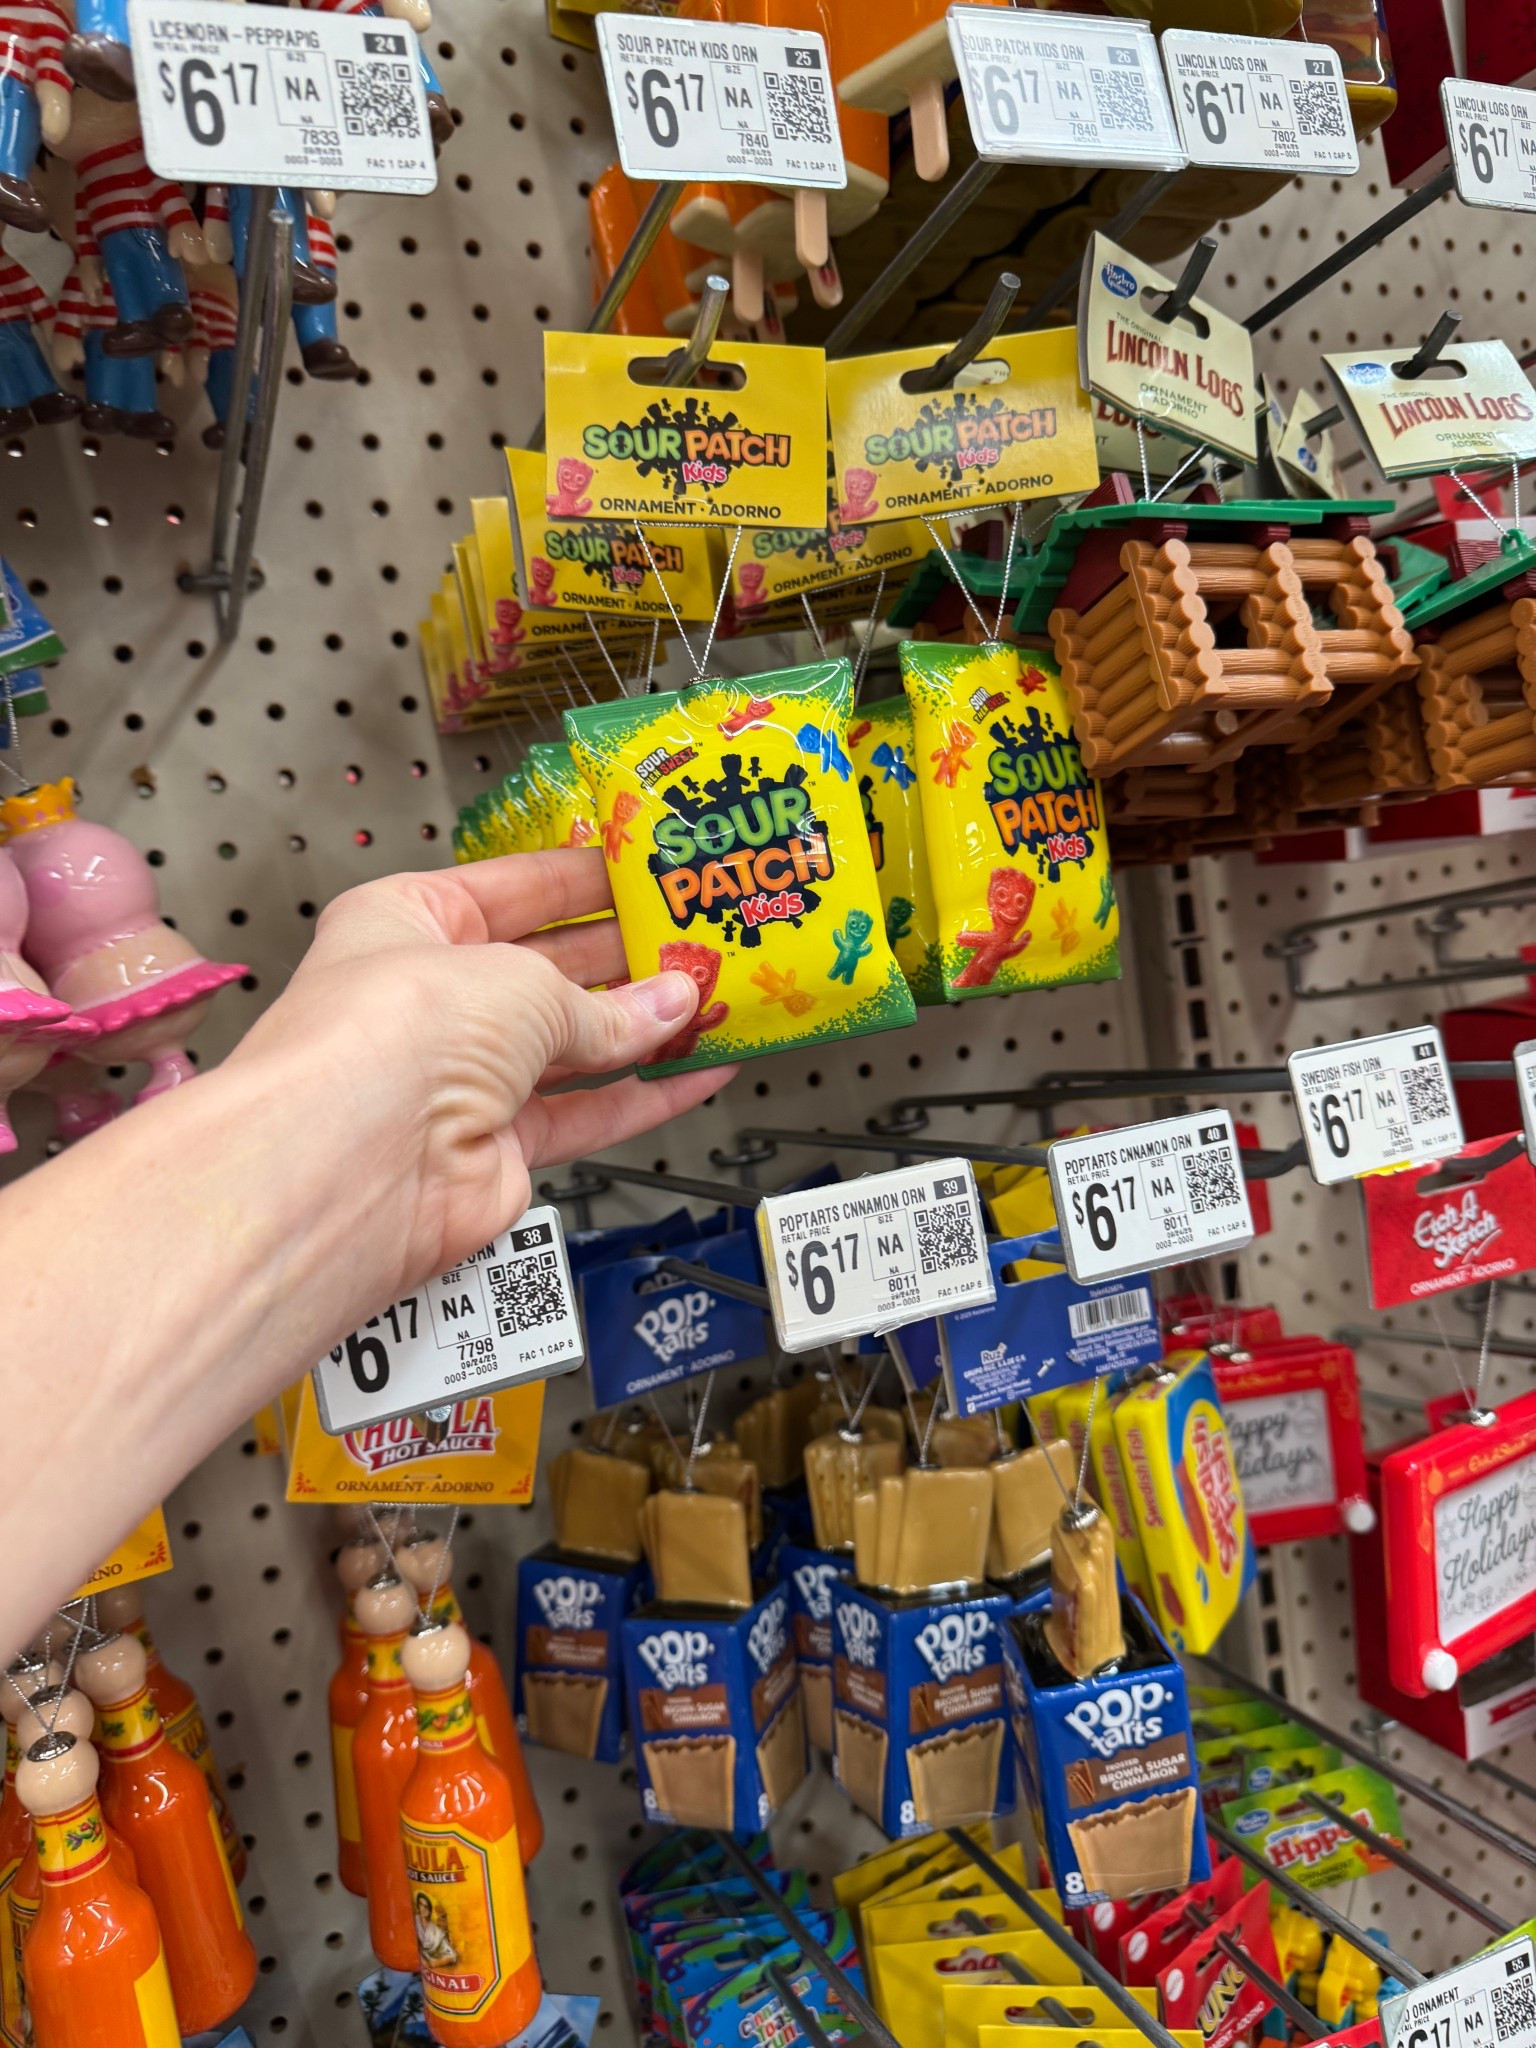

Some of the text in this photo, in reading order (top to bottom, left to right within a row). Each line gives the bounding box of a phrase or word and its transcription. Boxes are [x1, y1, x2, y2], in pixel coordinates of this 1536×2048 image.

[374, 35, 397, 53] 24
[617, 33, 758, 63] SOUR PATCH KIDS ORN
[962, 34, 1085, 61] SOUR PATCH KIDS ORN
[795, 50, 811, 66] 25
[1116, 50, 1131, 64] 26
[1175, 53, 1268, 72] LINCOLN LOGS ORN
[1312, 62, 1326, 74] 27
[1178, 69, 1220, 79] RETAIL PRICE
[284, 76, 320, 102] NA
[724, 87, 753, 109] NA
[1056, 80, 1083, 101] NA
[1260, 92, 1283, 111] NA
[1453, 95, 1529, 119] LINCOLN LOGS ORN
[299, 129, 340, 146] 7833
[739, 132, 769, 149] 7840
[1070, 122, 1098, 137] 7840
[1271, 130, 1297, 143] 7802
[811, 162, 826, 171] CAP
[1103, 262, 1136, 292] Hasbro
[1116, 312, 1164, 345] THE ORIGINAL
[1107, 320, 1245, 418] LINCOLN LOGS
[1139, 383, 1208, 414] ORNAMENT
[1378, 392, 1534, 440] LINCOLN LOGS
[583, 425, 791, 467] SOUR PATCH
[865, 424, 954, 465] SOUR
[955, 408, 1056, 449] PATCH
[1436, 431, 1497, 443] ORNAMENT
[1451, 440, 1493, 449] ADORNO
[956, 447, 999, 470] Kids
[682, 460, 727, 483] Kids
[885, 474, 1053, 508] ORNAMENT ADORNO
[600, 497, 781, 519] ORNAMENT ADORNO
[545, 530, 683, 572] SOUR PATCH
[829, 530, 864, 551] Kids
[612, 567, 643, 585] Kids
[773, 547, 912, 593] ORNAMENT ADORNO
[562, 592, 683, 615] ORNAMENT ADORNO
[969, 686, 991, 711] SOUR
[635, 747, 670, 779] SOUR
[989, 745, 1087, 797] SOUR
[655, 786, 810, 866] SOUR
[991, 789, 1099, 847] PATCH
[1046, 834, 1087, 863] Kids
[659, 833, 832, 921] PATCH
[740, 892, 803, 928] Kids
[1419, 1045, 1429, 1057] 41
[1301, 1067, 1340, 1087] SWEDISH
[1343, 1061, 1362, 1077] FISH
[1363, 1057, 1381, 1072] ORN
[1375, 1089, 1396, 1110] NA
[1206, 1128, 1220, 1141] 40
[1388, 1125, 1408, 1141] 7841
[1065, 1134, 1192, 1176] POPTARTS CNNAMON ORN
[1151, 1159, 1165, 1168] SIZE
[942, 1180, 958, 1195] 39
[1068, 1169, 1110, 1185] RETAIL PRICE
[1150, 1177, 1175, 1198] NA
[779, 1187, 926, 1234] POPTARTS CNNAMON ORN
[878, 1214, 893, 1224] SIZE
[1413, 1190, 1478, 1249] Etch A
[1164, 1215, 1190, 1231] 8011
[1207, 1222, 1240, 1237] FAC CAP
[523, 1229, 541, 1246] 38
[782, 1226, 831, 1244] RETAIL PRICE
[877, 1233, 904, 1257] NA
[1433, 1210, 1497, 1269] Sketch
[443, 1272, 461, 1285] SIZE
[889, 1266, 899, 1275] NA
[888, 1273, 918, 1292] 8011
[938, 1283, 976, 1298] FAC CAP
[1411, 1270, 1466, 1295] ORNAMENT
[441, 1294, 475, 1321] NA
[457, 1331, 470, 1340] NA
[457, 1338, 493, 1360] 7798
[519, 1343, 564, 1362] FAC CAP
[445, 1363, 498, 1385] 0003-0003
[626, 1349, 735, 1394] ORNAMENT ADORNO
[383, 1436, 484, 1463] HOT SAUCE
[336, 1480, 494, 1493] ORNAMENT ADORNO
[1126, 1428, 1164, 1528] Swedish Fish
[1457, 1481, 1519, 1538] Happy
[1442, 1519, 1536, 1600] Holidays
[1099, 1753, 1186, 1785] BROWN SUGAR
[1112, 1766, 1179, 1791] CINNAMON
[900, 1800, 915, 1825] 8
[421, 1872, 456, 1883] SAUCE
[1065, 1872, 1084, 1894] 8
[1413, 1987, 1460, 2018] ORNAMENT
[1464, 2011, 1484, 2032] NA
